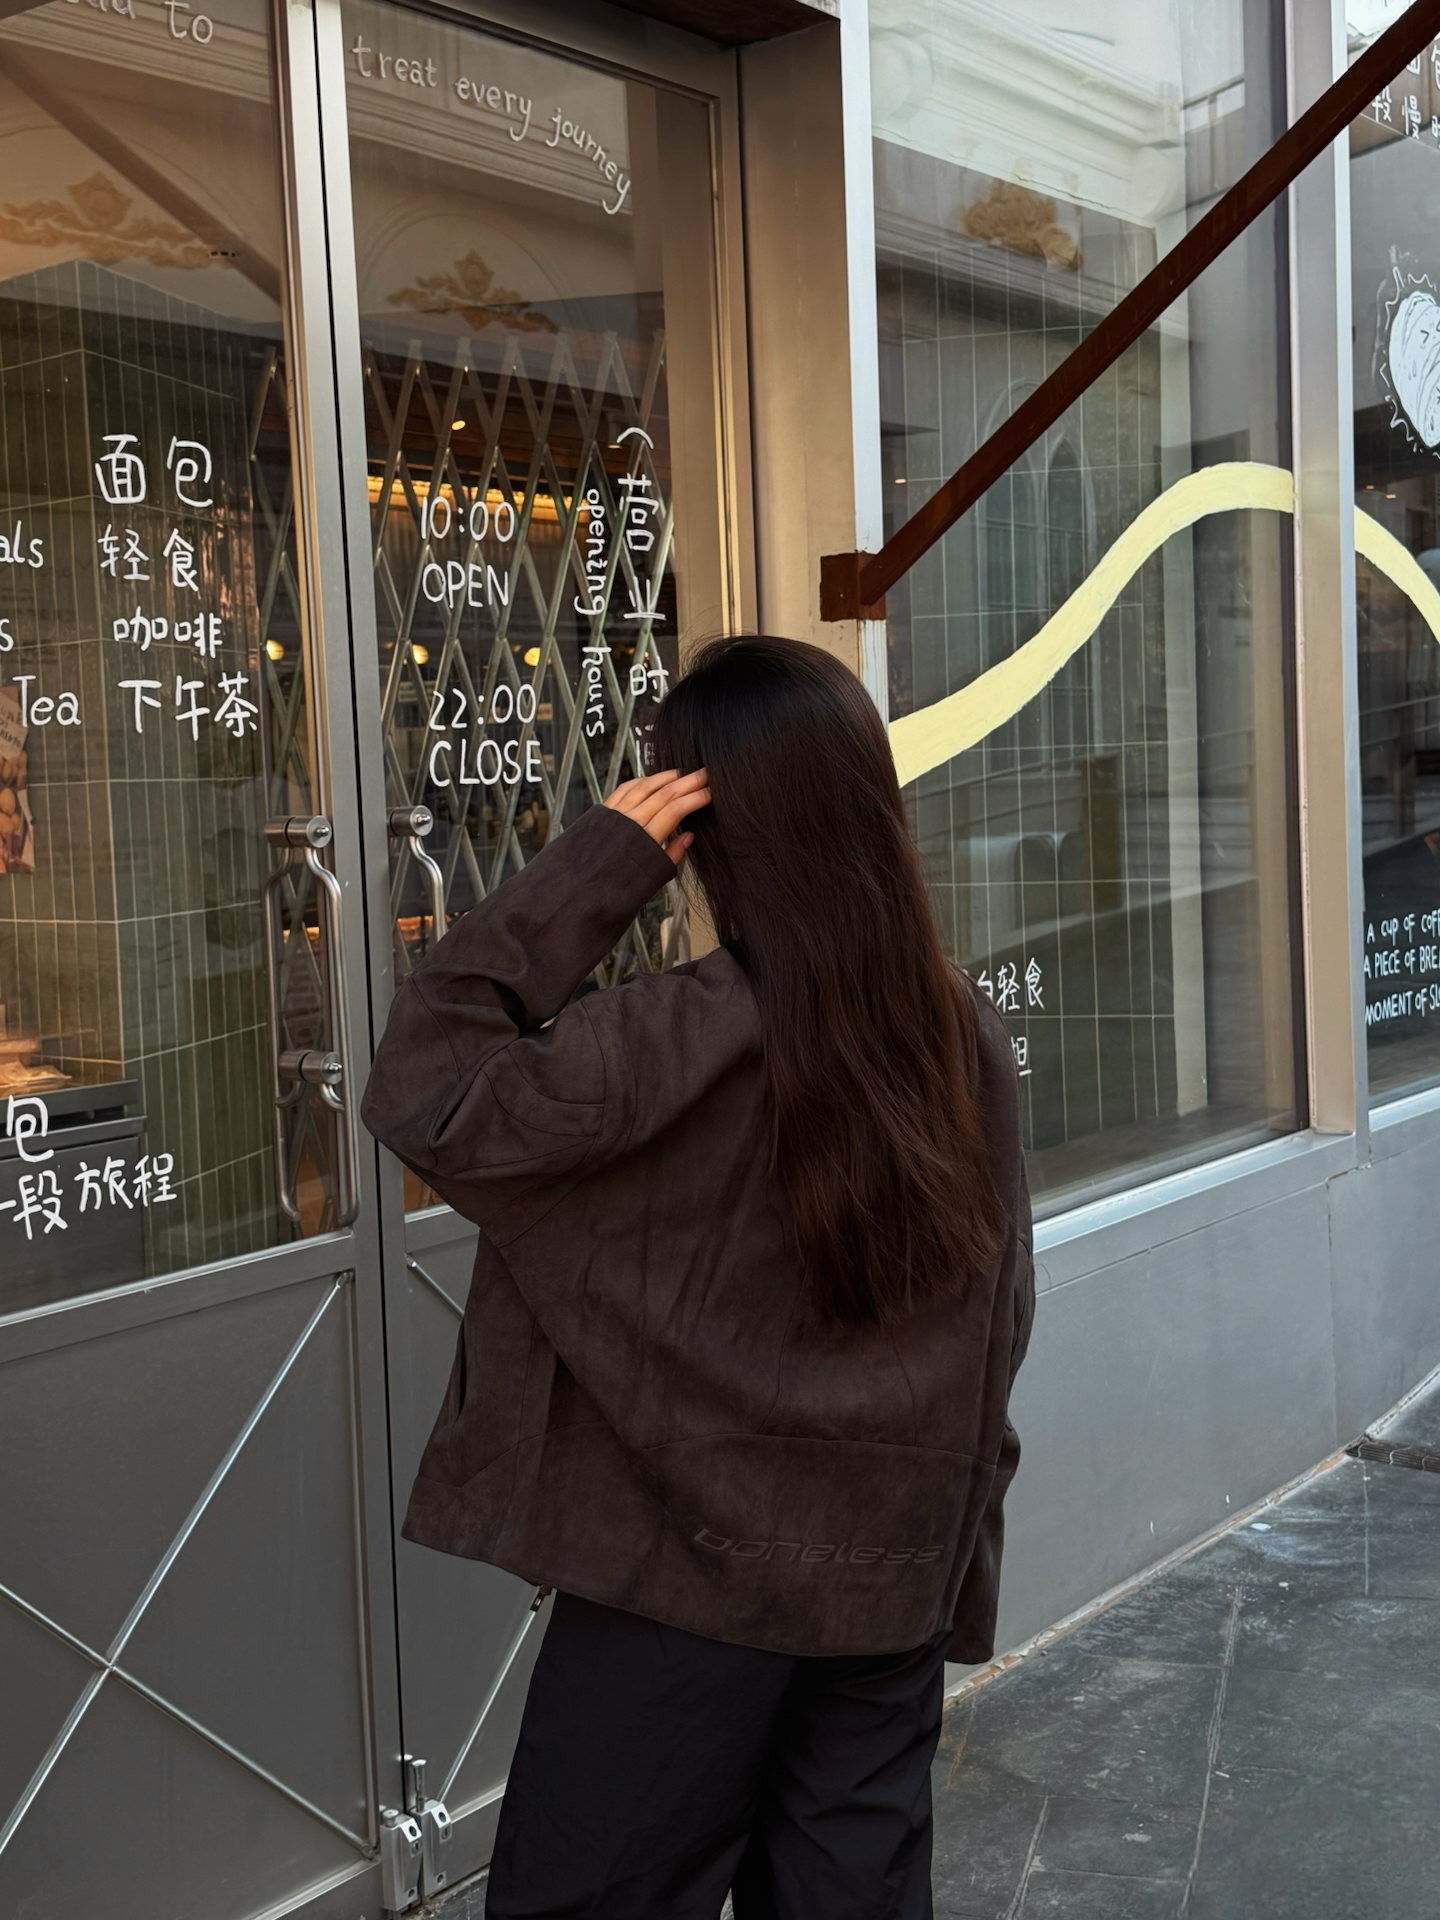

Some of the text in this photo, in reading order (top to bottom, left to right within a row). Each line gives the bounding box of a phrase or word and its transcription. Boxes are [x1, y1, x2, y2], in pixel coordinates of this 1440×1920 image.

[164, 0, 214, 44] to
[352, 35, 632, 215] treat every journey
[94, 433, 213, 508] 面包
[420, 496, 516, 543] 10:00
[97, 523, 199, 592] 轻食
[422, 560, 509, 609] OPEN
[112, 605, 223, 659] 咖啡
[573, 488, 611, 738] opening hours
[12, 674, 82, 728] Tea
[117, 670, 259, 742] 下午茶
[429, 683, 537, 731] 22:00
[429, 739, 543, 787] CLOSE
[1366, 922, 1376, 945] A
[1363, 954, 1373, 979] A
[1374, 949, 1401, 979] PIECE
[1419, 945, 1440, 974] BRE
[1364, 990, 1414, 1027] MOMENT
[693, 1527, 945, 1565] boneless
